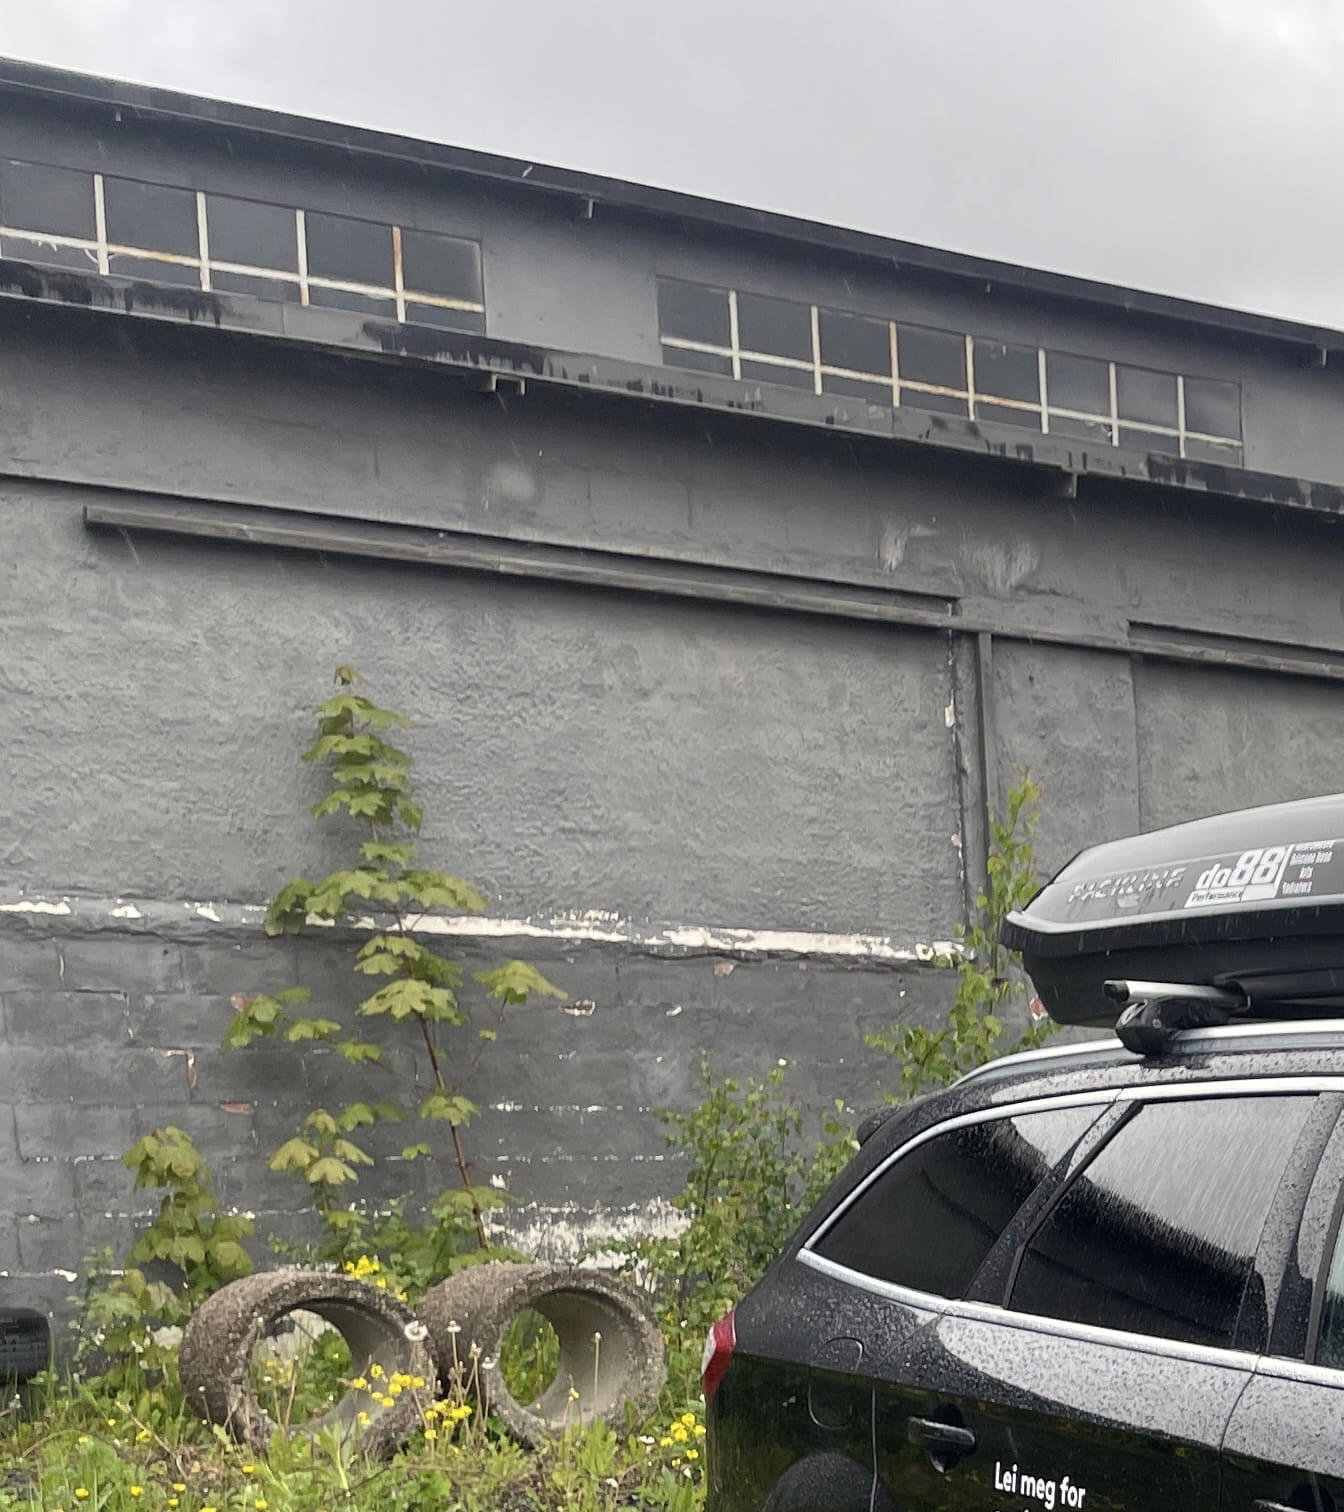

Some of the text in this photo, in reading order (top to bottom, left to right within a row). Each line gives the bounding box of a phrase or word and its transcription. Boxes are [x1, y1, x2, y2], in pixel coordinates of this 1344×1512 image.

[994, 1461, 1086, 1510] Lei meg for
